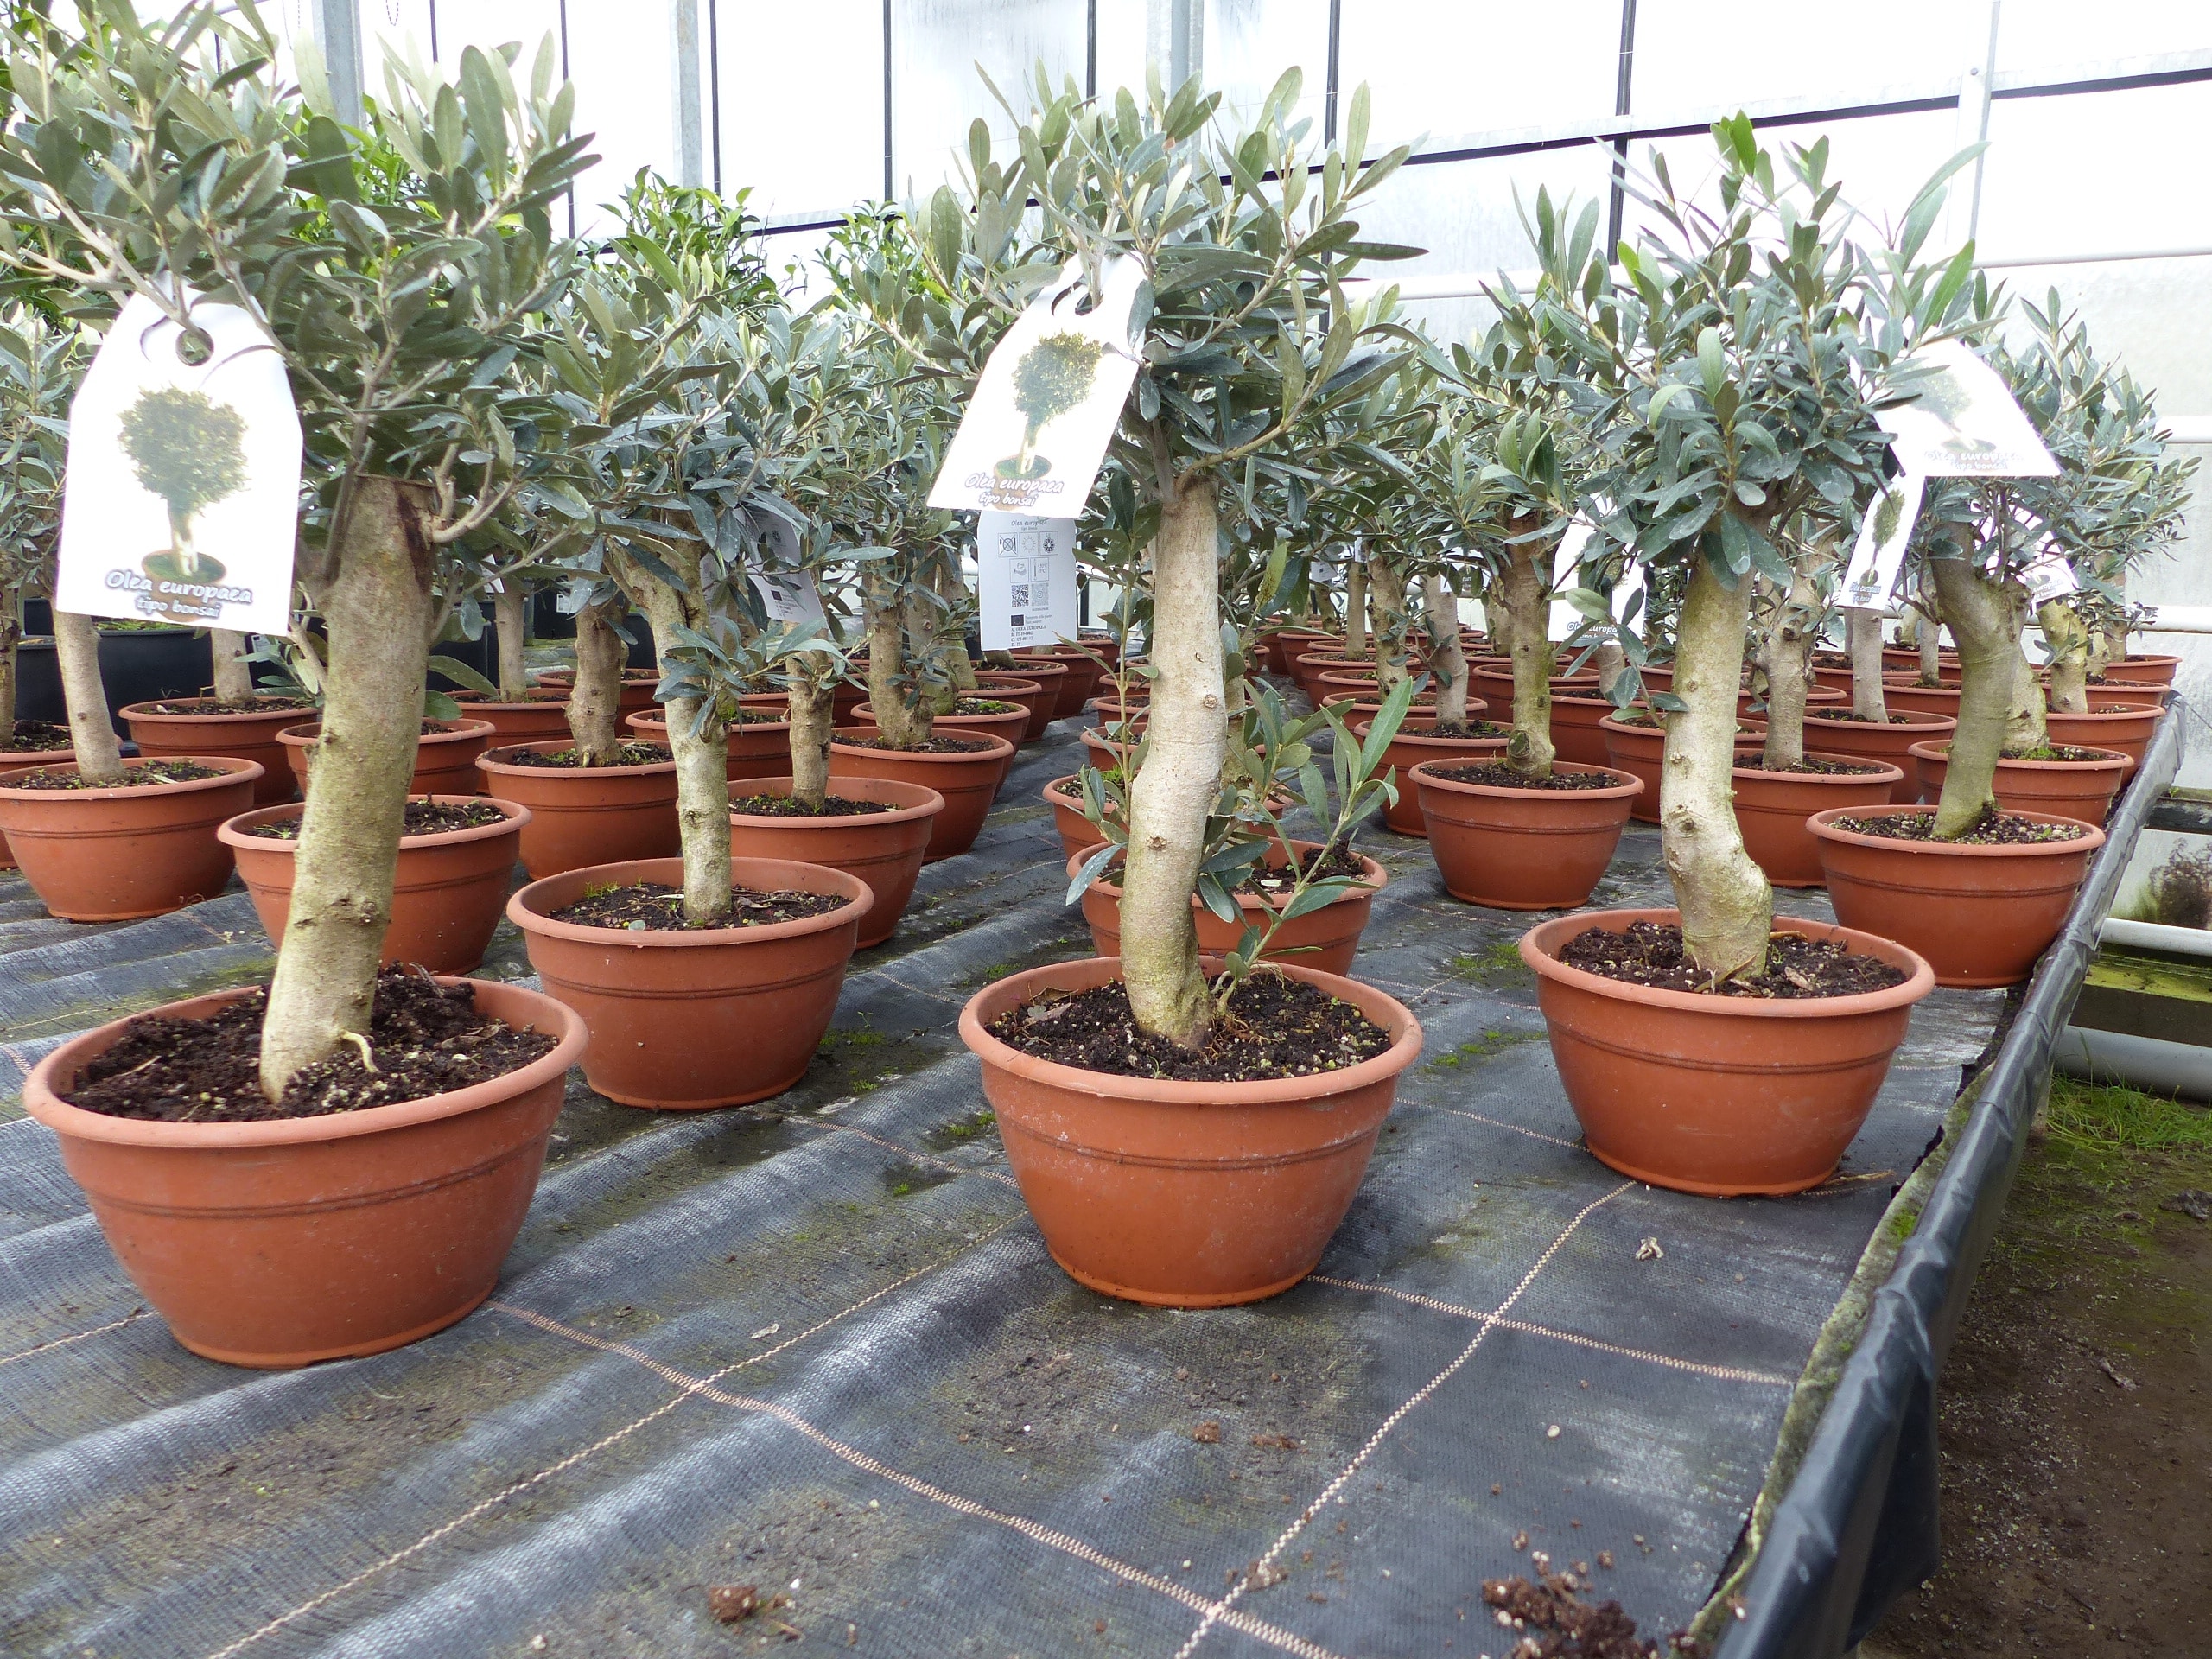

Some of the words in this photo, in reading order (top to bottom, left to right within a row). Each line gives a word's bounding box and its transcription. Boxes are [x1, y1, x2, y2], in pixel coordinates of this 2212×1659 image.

[965, 473, 996, 489] Olea
[1000, 477, 1064, 495] europaea
[979, 492, 1001, 506] tipo
[1002, 493, 1038, 506] bonsai
[105, 569, 153, 592] Olea
[159, 580, 253, 603] europaea
[136, 596, 168, 615] tipo
[171, 599, 222, 618] bonsai
